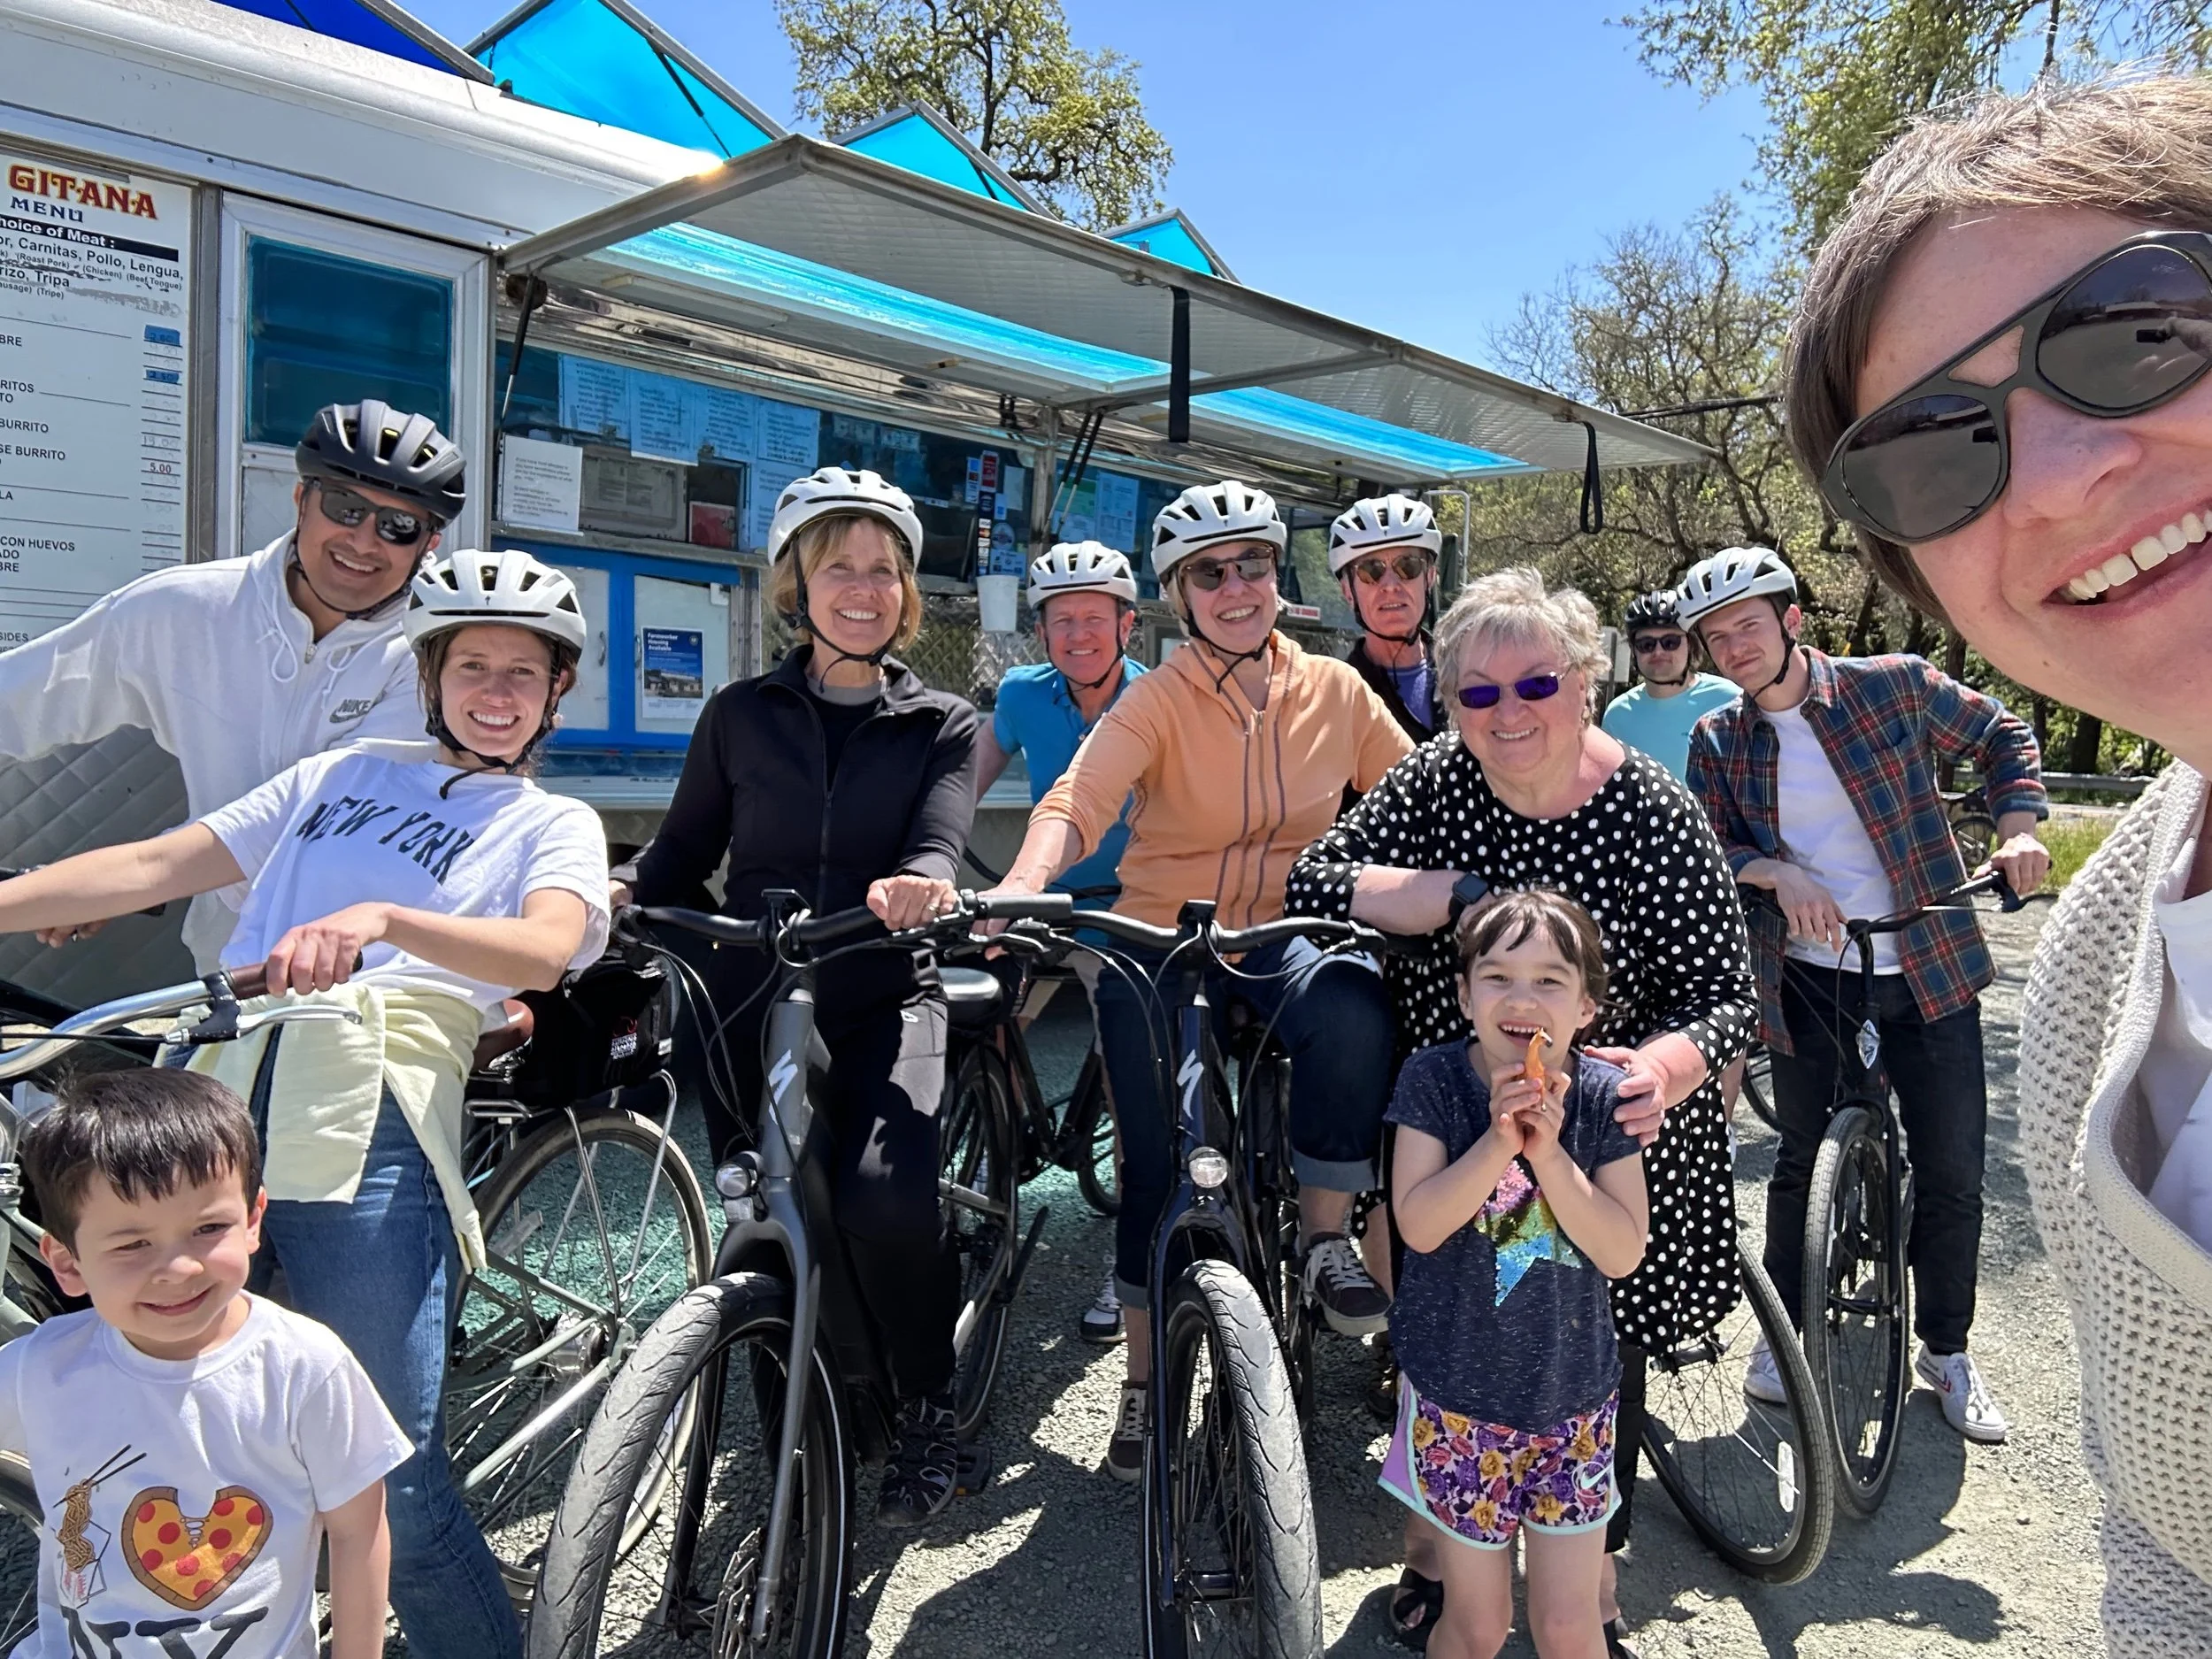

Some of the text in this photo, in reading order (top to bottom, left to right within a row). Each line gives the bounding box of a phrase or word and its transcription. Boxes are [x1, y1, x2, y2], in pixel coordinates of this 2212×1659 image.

[8, 164, 158, 220] GITANA
[11, 196, 83, 223] MENU
[46, 227, 64, 238] of
[67, 228, 105, 247] Meat
[19, 237, 81, 261] Carnitas,
[87, 250, 125, 270] Pollo,
[130, 258, 183, 280] Lengua,
[17, 253, 45, 264] (Roast
[47, 258, 70, 269] Pork)
[82, 265, 122, 280] (Chicken)
[150, 277, 182, 291] Tongue)
[35, 270, 70, 288] Tripa
[37, 287, 65, 300] (Tripe)
[0, 334, 22, 347] BRE
[0, 380, 35, 393] RITOS
[0, 418, 49, 434] BURRITO
[15, 445, 65, 460] BURRITO
[150, 462, 172, 473] 5.00
[0, 535, 75, 552] CON HUEVOS
[338, 698, 372, 713] NIKE
[295, 795, 475, 887] NEW YORK
